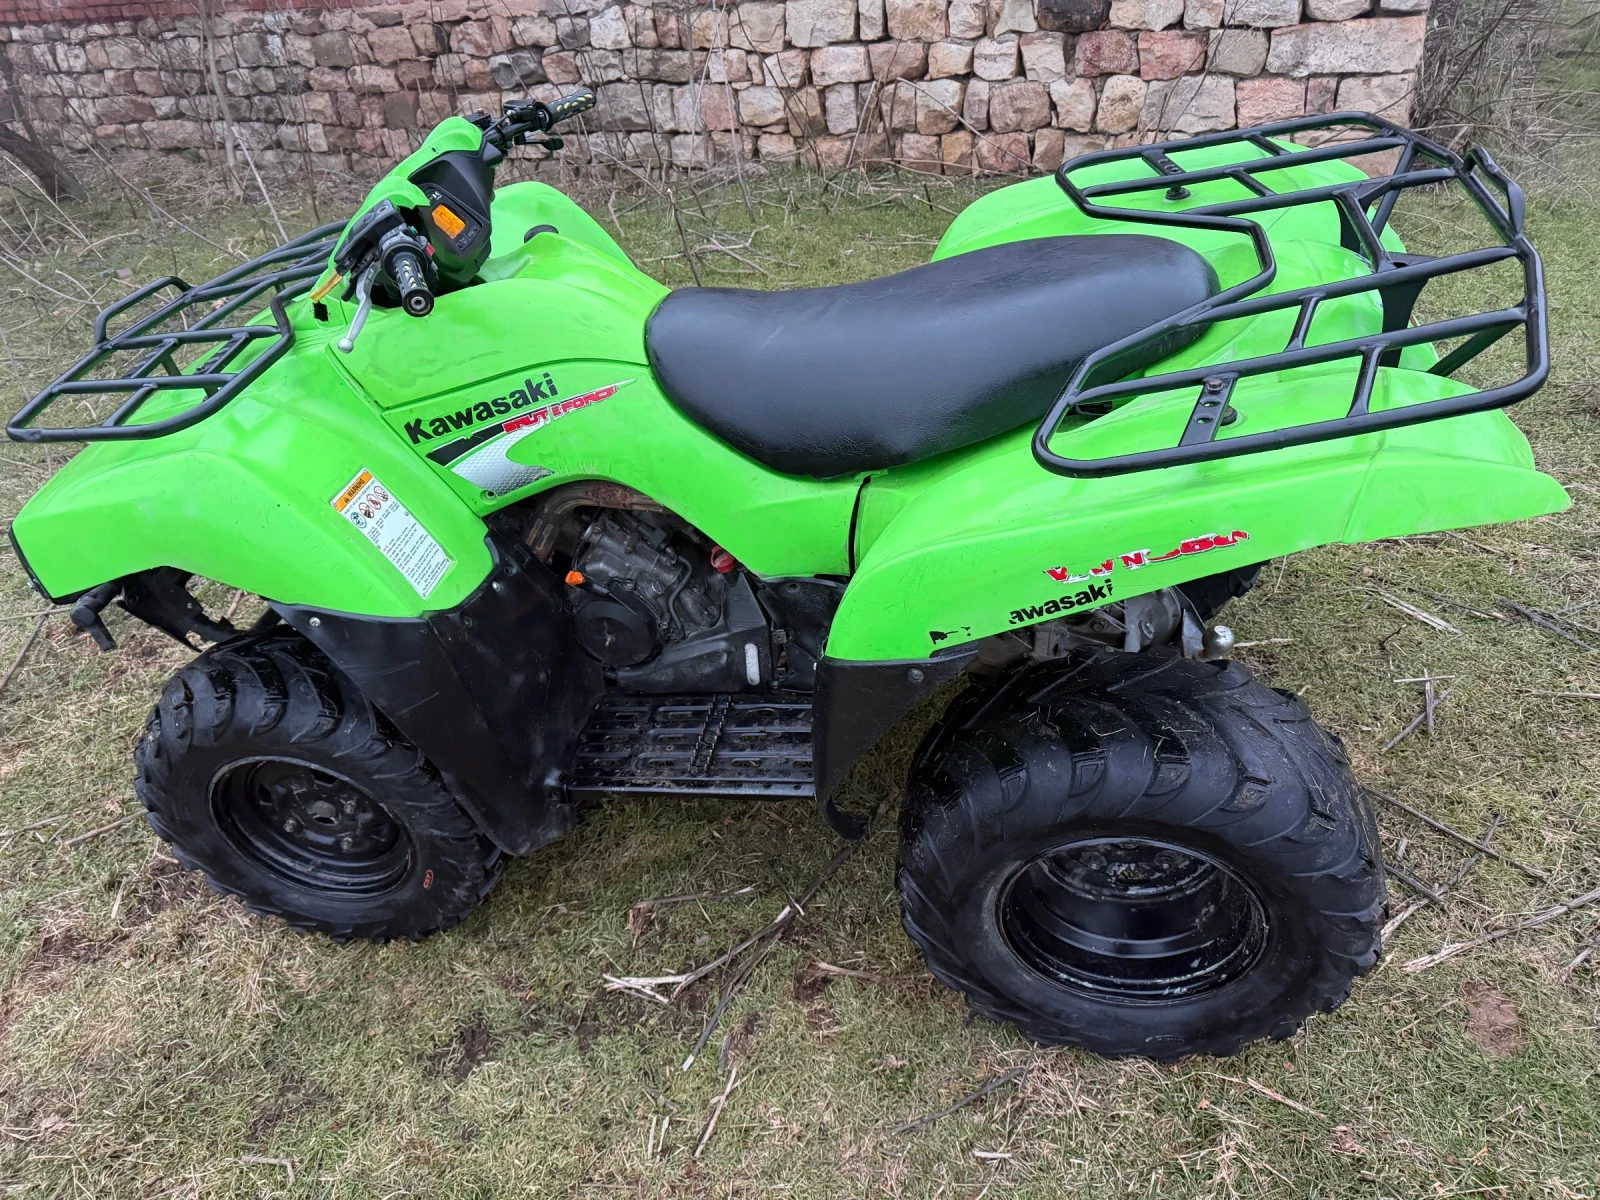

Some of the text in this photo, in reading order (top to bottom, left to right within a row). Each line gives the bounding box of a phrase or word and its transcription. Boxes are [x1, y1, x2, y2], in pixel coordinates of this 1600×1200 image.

[404, 372, 558, 445] Kawasaki
[347, 478, 366, 498] WARNING
[1008, 578, 1114, 625] awasaki
